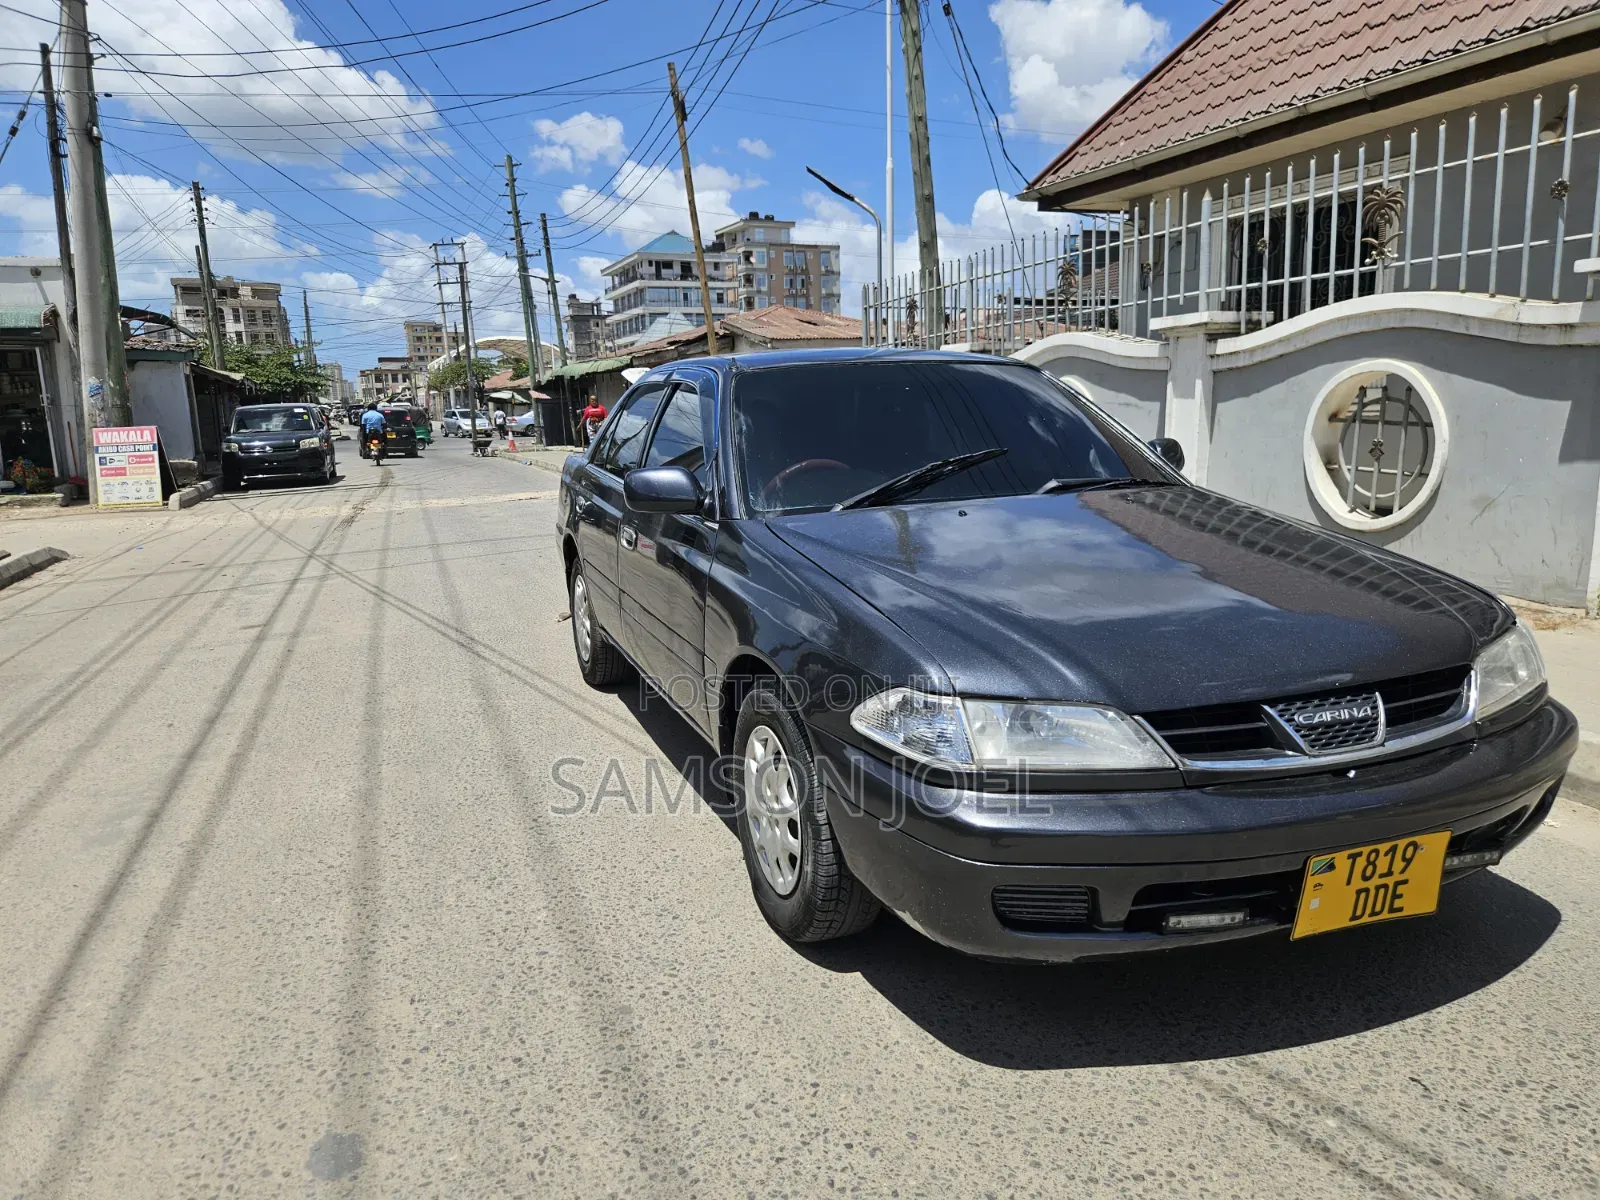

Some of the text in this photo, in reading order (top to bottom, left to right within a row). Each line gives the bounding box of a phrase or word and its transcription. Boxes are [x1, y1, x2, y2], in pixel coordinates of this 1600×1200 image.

[98, 430, 152, 443] WAKALA
[1297, 706, 1372, 724] CARINA
[1345, 840, 1419, 886] T819
[1349, 878, 1409, 922] DDE
